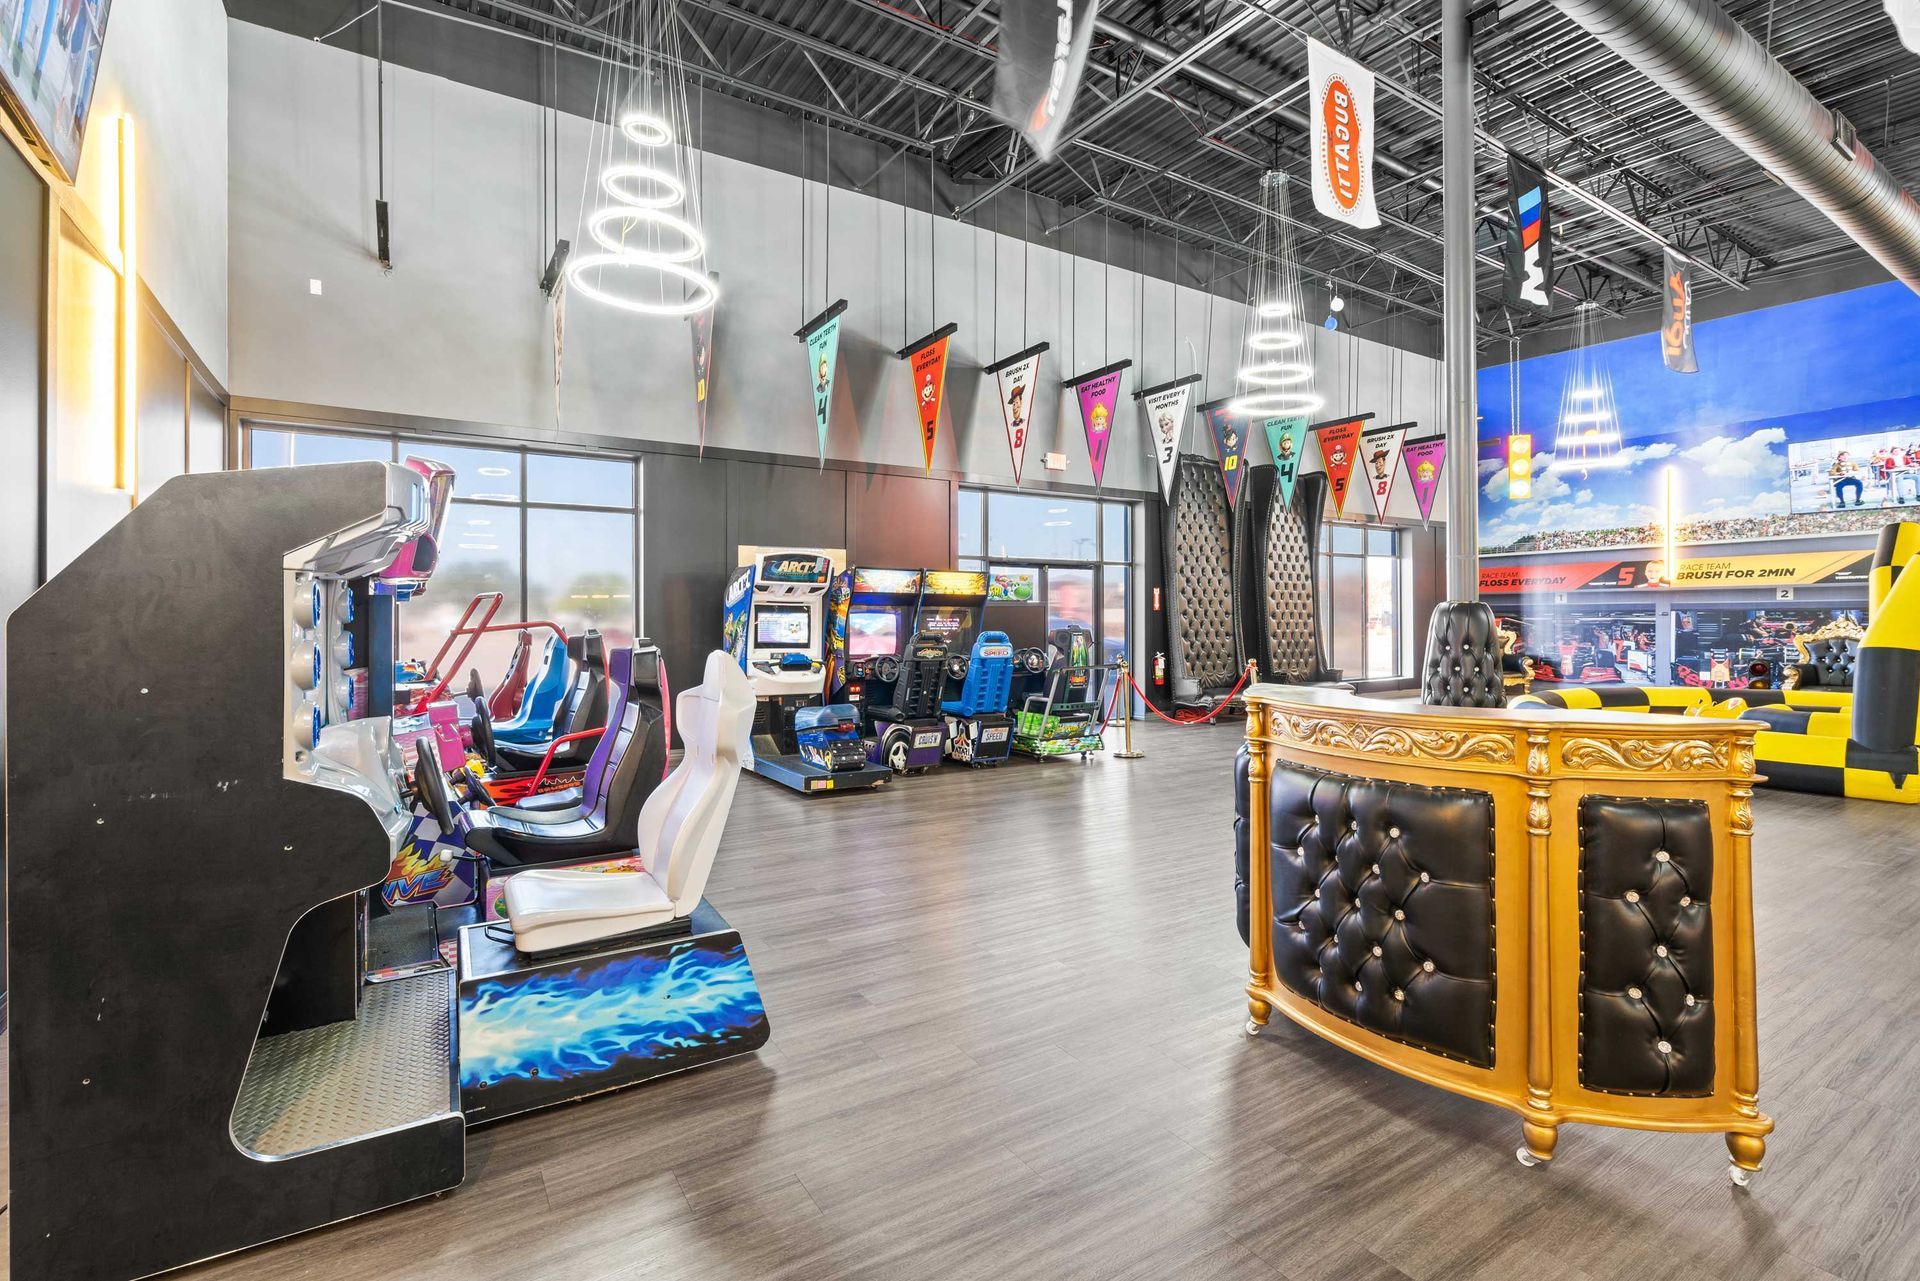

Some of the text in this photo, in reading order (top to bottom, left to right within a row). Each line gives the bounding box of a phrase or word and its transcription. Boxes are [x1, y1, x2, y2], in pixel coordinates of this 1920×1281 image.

[809, 323, 837, 346] CLEAN TEETH
[819, 341, 828, 351] FUN
[920, 348, 935, 360] FLOSS
[916, 356, 941, 372] EVERYDAY
[1005, 366, 1022, 377] BRUSH
[1013, 375, 1023, 383] DAY
[1080, 376, 1116, 393] EAT HEALTHY
[1090, 388, 1106, 398] FOOD
[1162, 391, 1180, 401] EVERY
[817, 395, 828, 424] 4
[1155, 400, 1179, 410] MONTHS
[1266, 418, 1285, 427] CLEAN
[926, 420, 934, 440] 5
[1328, 427, 1347, 435] FLOSS
[1014, 428, 1023, 448] 8
[1323, 432, 1354, 443] EVERYDAY
[1417, 442, 1444, 451] HEALTHY
[1162, 447, 1173, 464] 3
[1224, 454, 1238, 471] 10
[1281, 463, 1294, 483] 4
[1335, 478, 1345, 491] 5
[1376, 481, 1387, 495] 8
[1680, 562, 1731, 571] RACE TEAM
[1500, 571, 1518, 579] TEAM
[1618, 567, 1635, 585] 5
[1677, 568, 1796, 580] BRUSH FOR 2MIN
[1479, 577, 1567, 587] FLOSS EVERYDAY
[1780, 590, 1789, 598] 2
[985, 732, 1003, 742] SPEED
